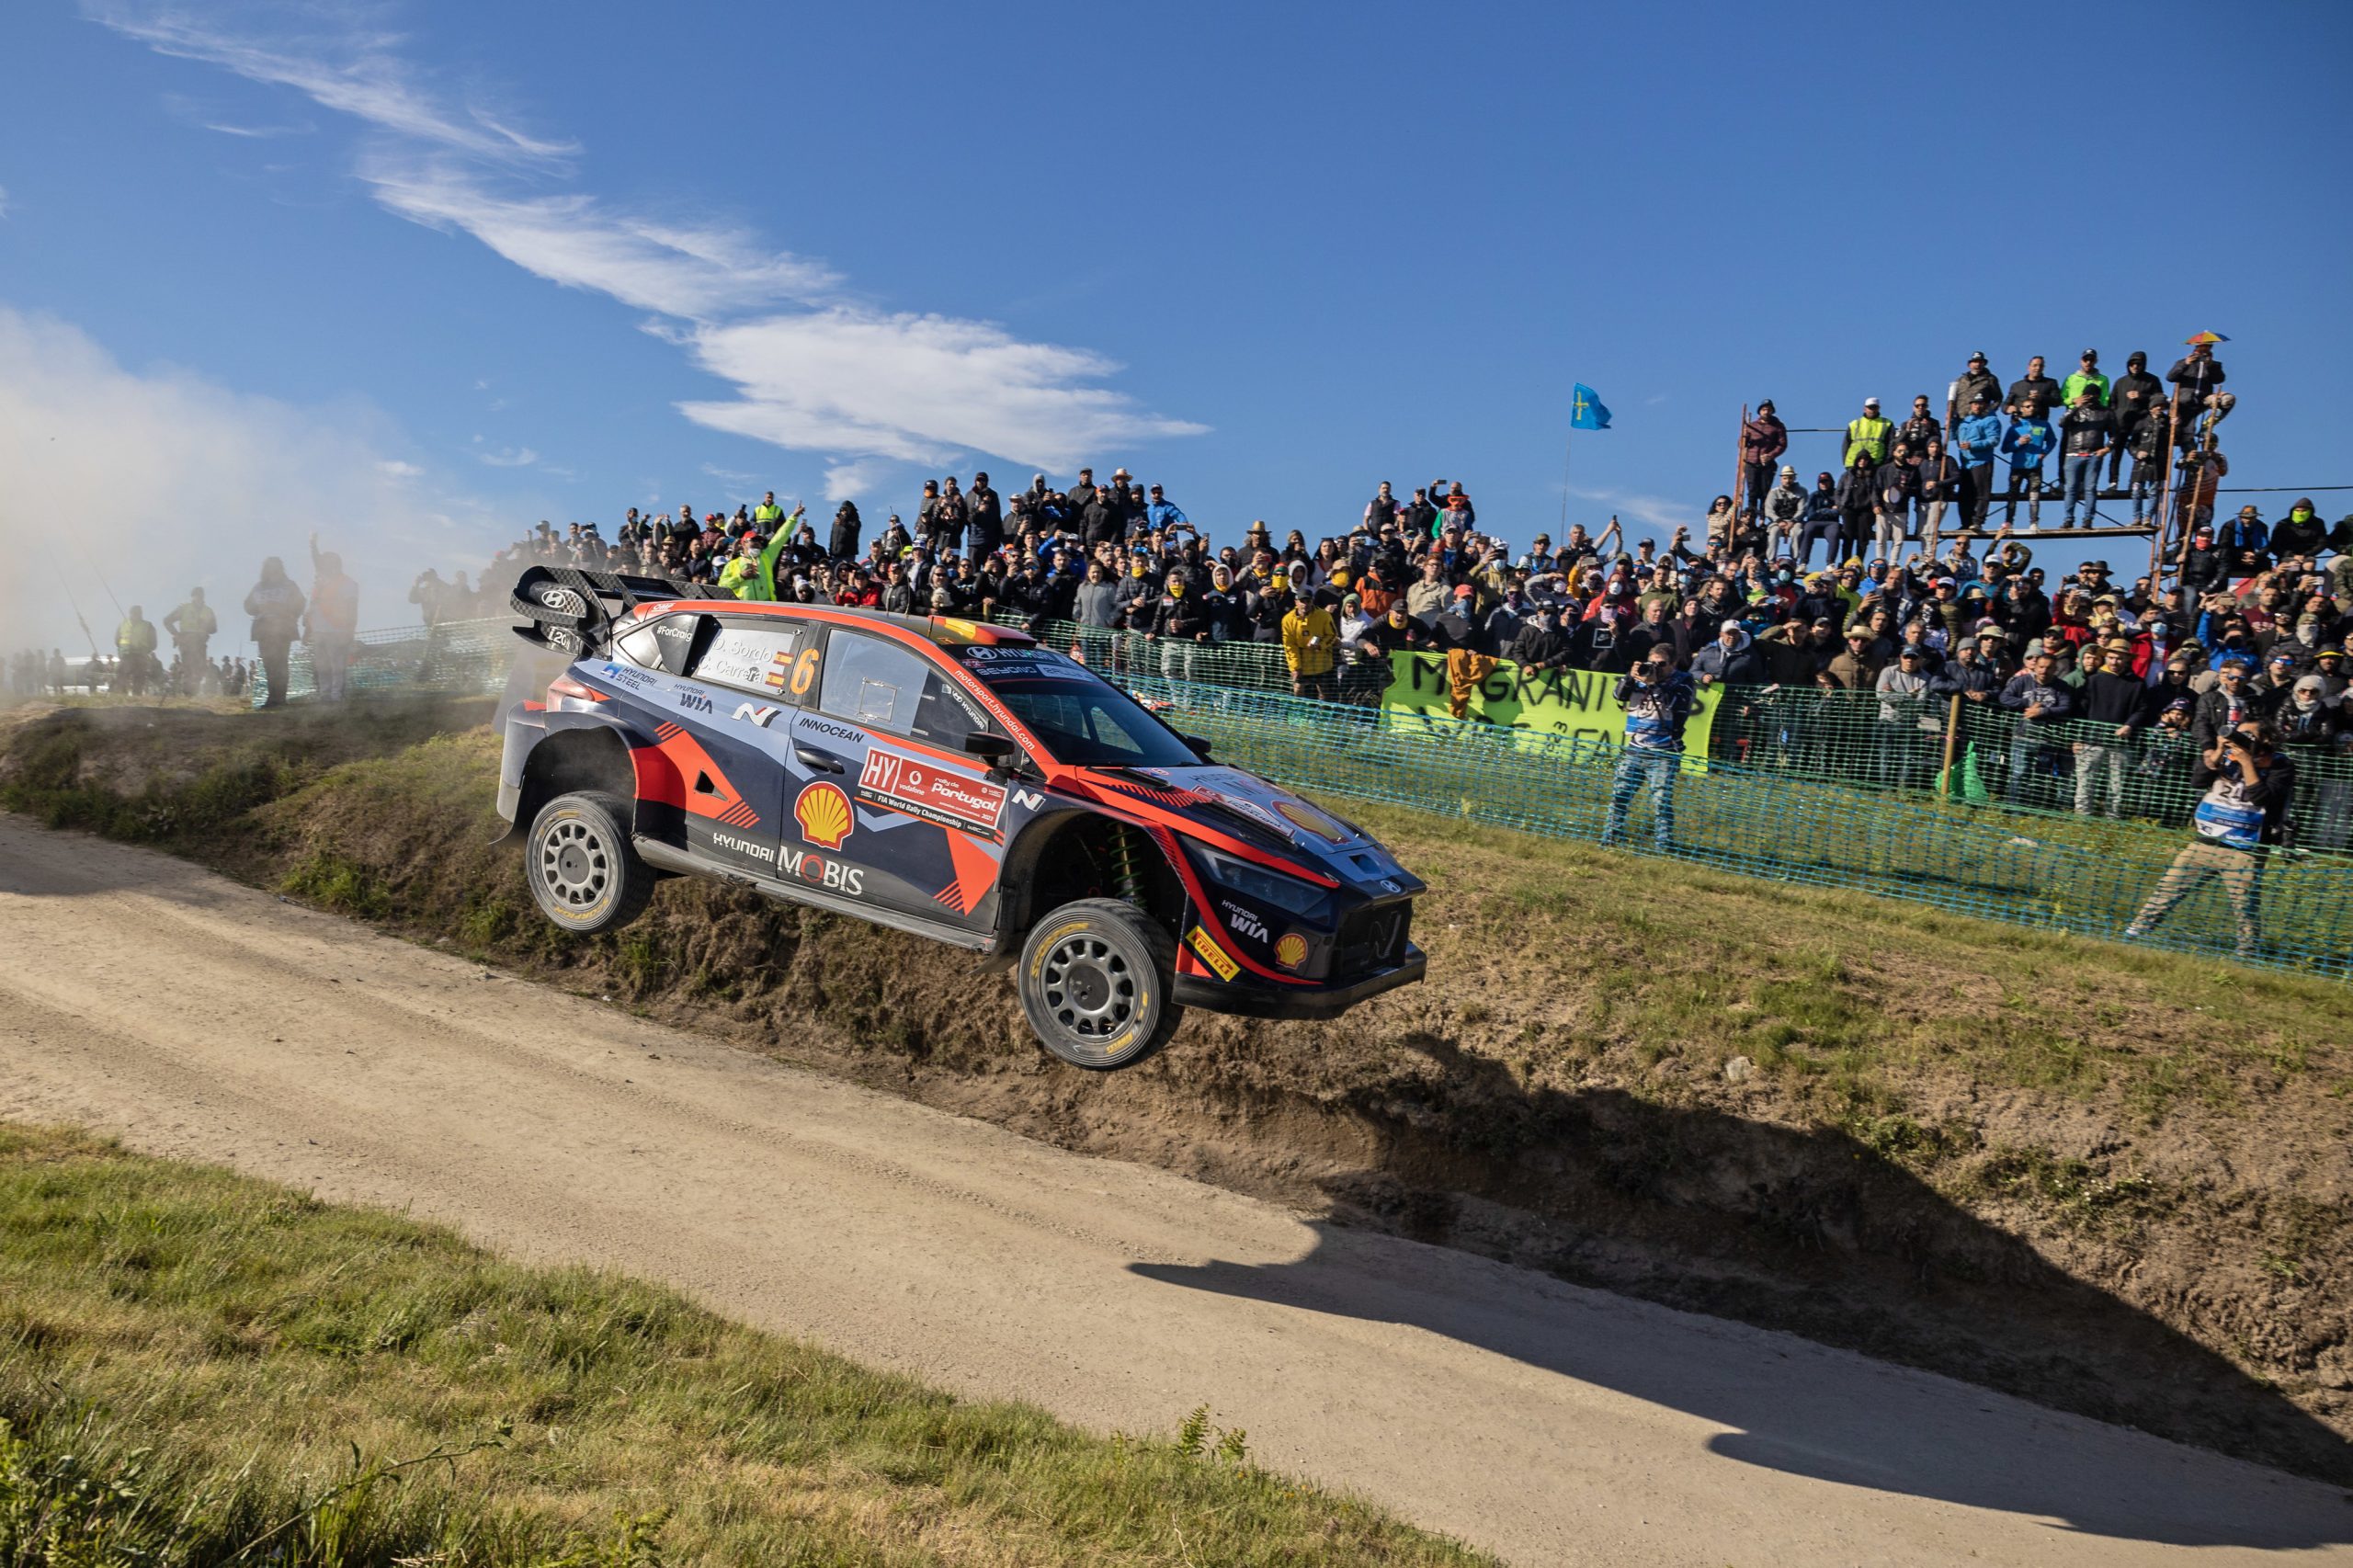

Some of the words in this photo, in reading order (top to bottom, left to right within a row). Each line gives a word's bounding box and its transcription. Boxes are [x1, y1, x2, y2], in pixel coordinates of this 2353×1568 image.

[657, 625, 693, 642] #ForCraig
[713, 637, 726, 653] D.
[732, 642, 773, 662] Sordo
[995, 647, 1056, 662] HYUNDAI
[616, 674, 641, 690] STEEL
[621, 666, 658, 687] HYUNDAI
[717, 660, 764, 684] Carrera
[791, 648, 820, 695] 6
[976, 666, 1038, 676] BEYOND
[674, 683, 705, 696] HYUNDAI
[680, 692, 712, 714] WIA
[955, 670, 1036, 751] motorsport.hyundai.com
[961, 701, 984, 730] HYUNDAI
[799, 717, 865, 744] INNOCEAN
[864, 754, 898, 789] HY
[935, 778, 950, 787] rally
[899, 784, 925, 796] vodafone
[931, 782, 997, 812] Portugal
[878, 795, 888, 803] FIA
[889, 799, 905, 809] World
[905, 804, 921, 815] Rally
[921, 809, 962, 828] Championship
[713, 833, 775, 863] HYUNDAI
[777, 846, 864, 896] MOBIS
[1222, 900, 1258, 921] HYUNDAI
[1230, 914, 1268, 944] WIA
[1191, 931, 1233, 975] PIRELLI
